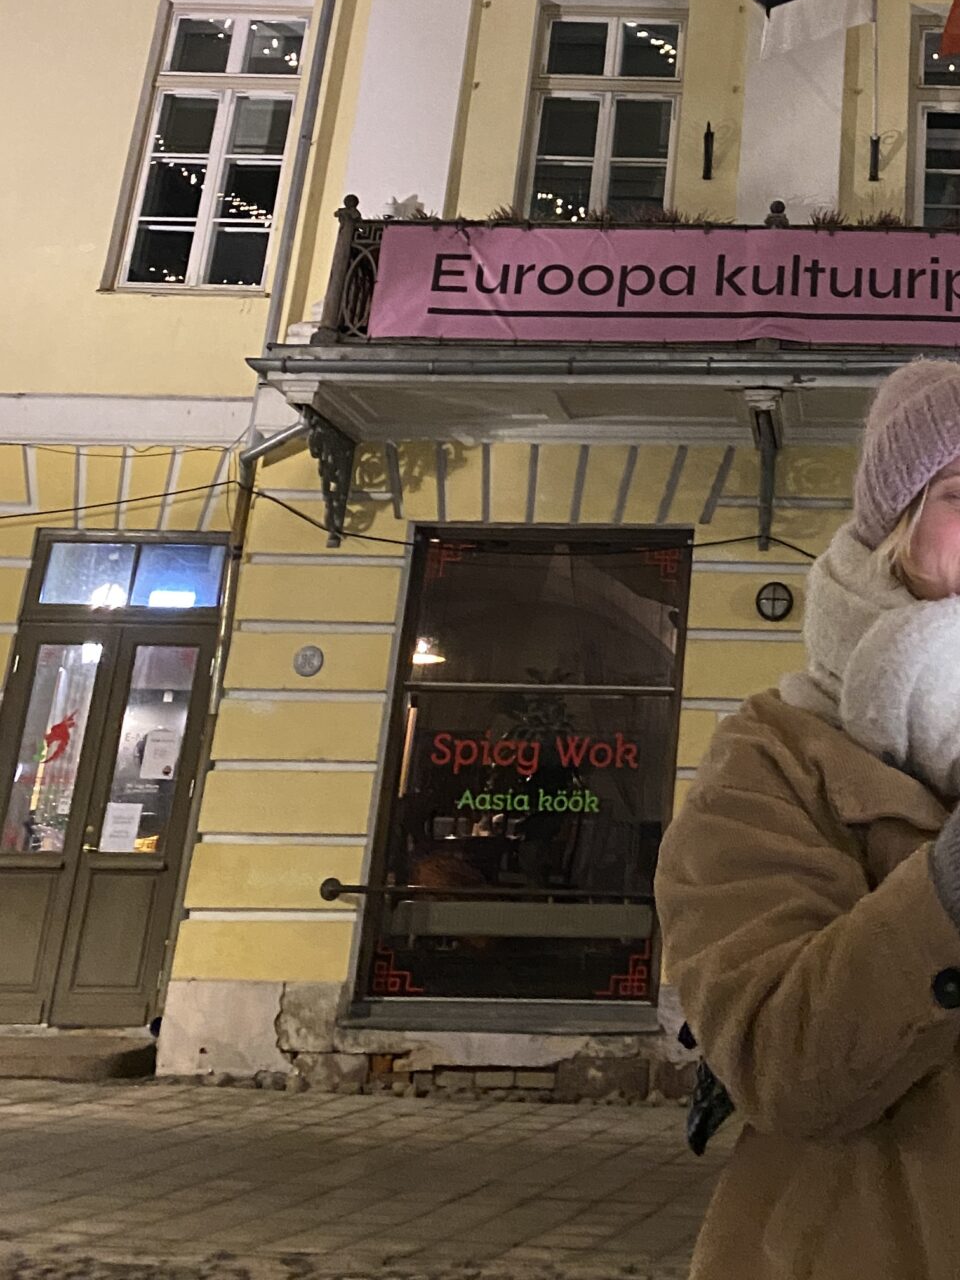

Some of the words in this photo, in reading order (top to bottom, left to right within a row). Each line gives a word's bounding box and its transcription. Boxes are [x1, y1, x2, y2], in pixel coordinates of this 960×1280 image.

[431, 253, 696, 307] Euroopa
[431, 729, 540, 775] Spicy
[556, 732, 639, 769] Wok
[455, 788, 530, 811] Aasia
[538, 788, 600, 812] köök
